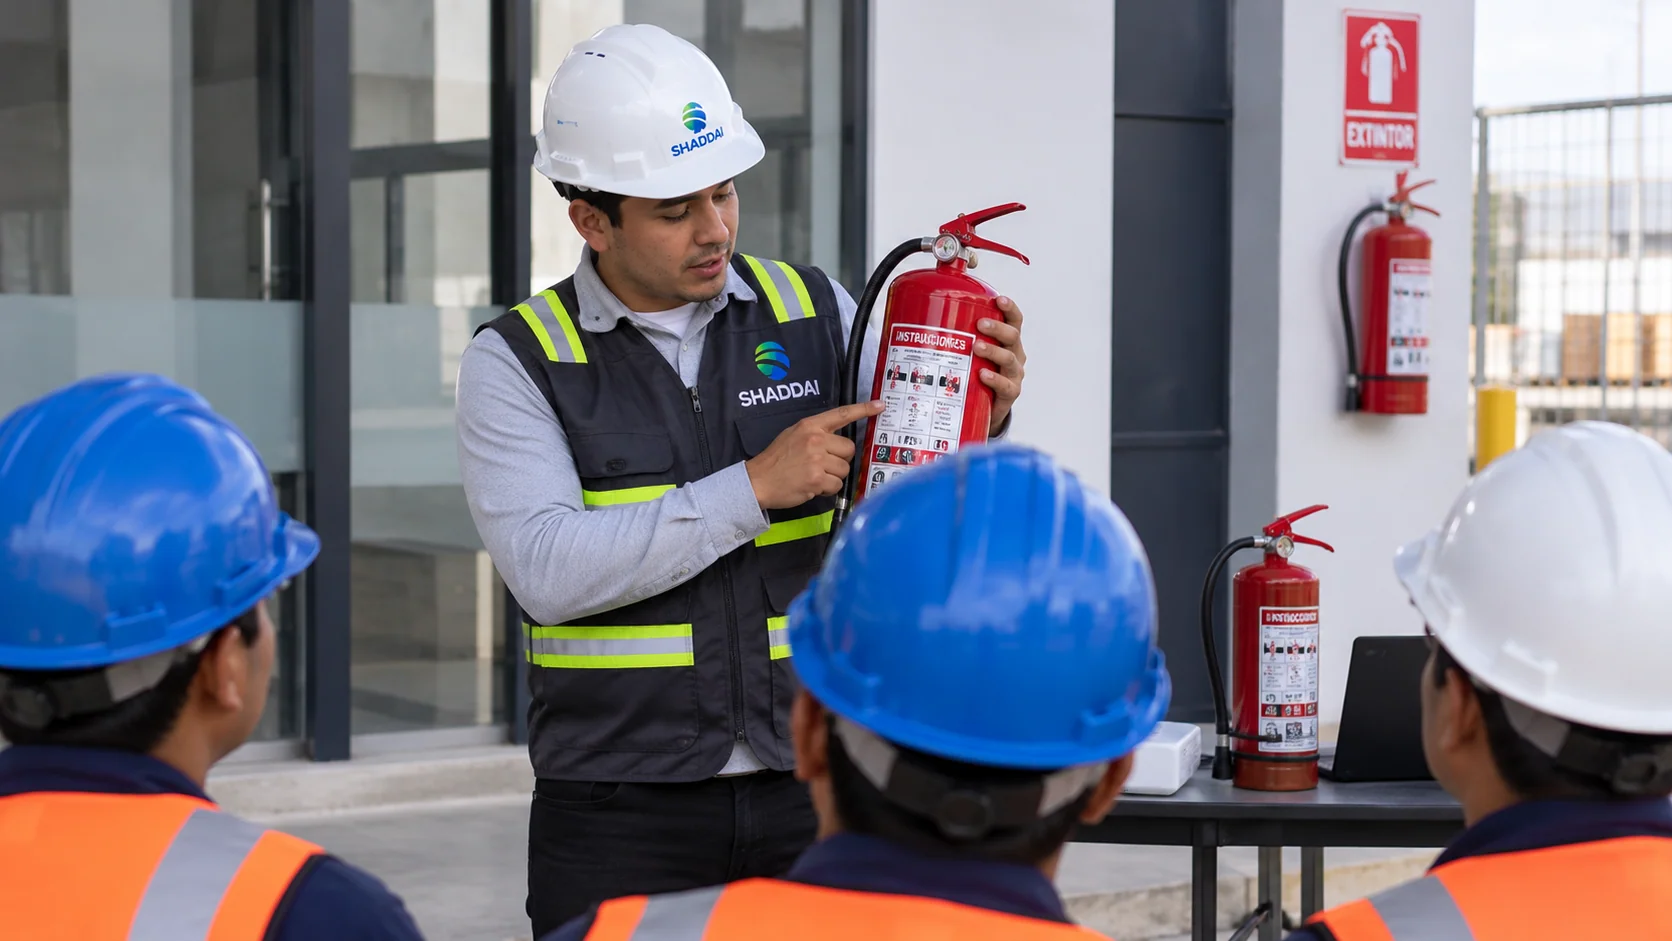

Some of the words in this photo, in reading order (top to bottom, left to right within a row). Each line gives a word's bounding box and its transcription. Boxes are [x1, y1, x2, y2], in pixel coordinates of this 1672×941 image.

[671, 126, 724, 157] SHADDAI
[1347, 121, 1414, 149] EXTINTOR
[738, 379, 820, 407] SHADDAI
